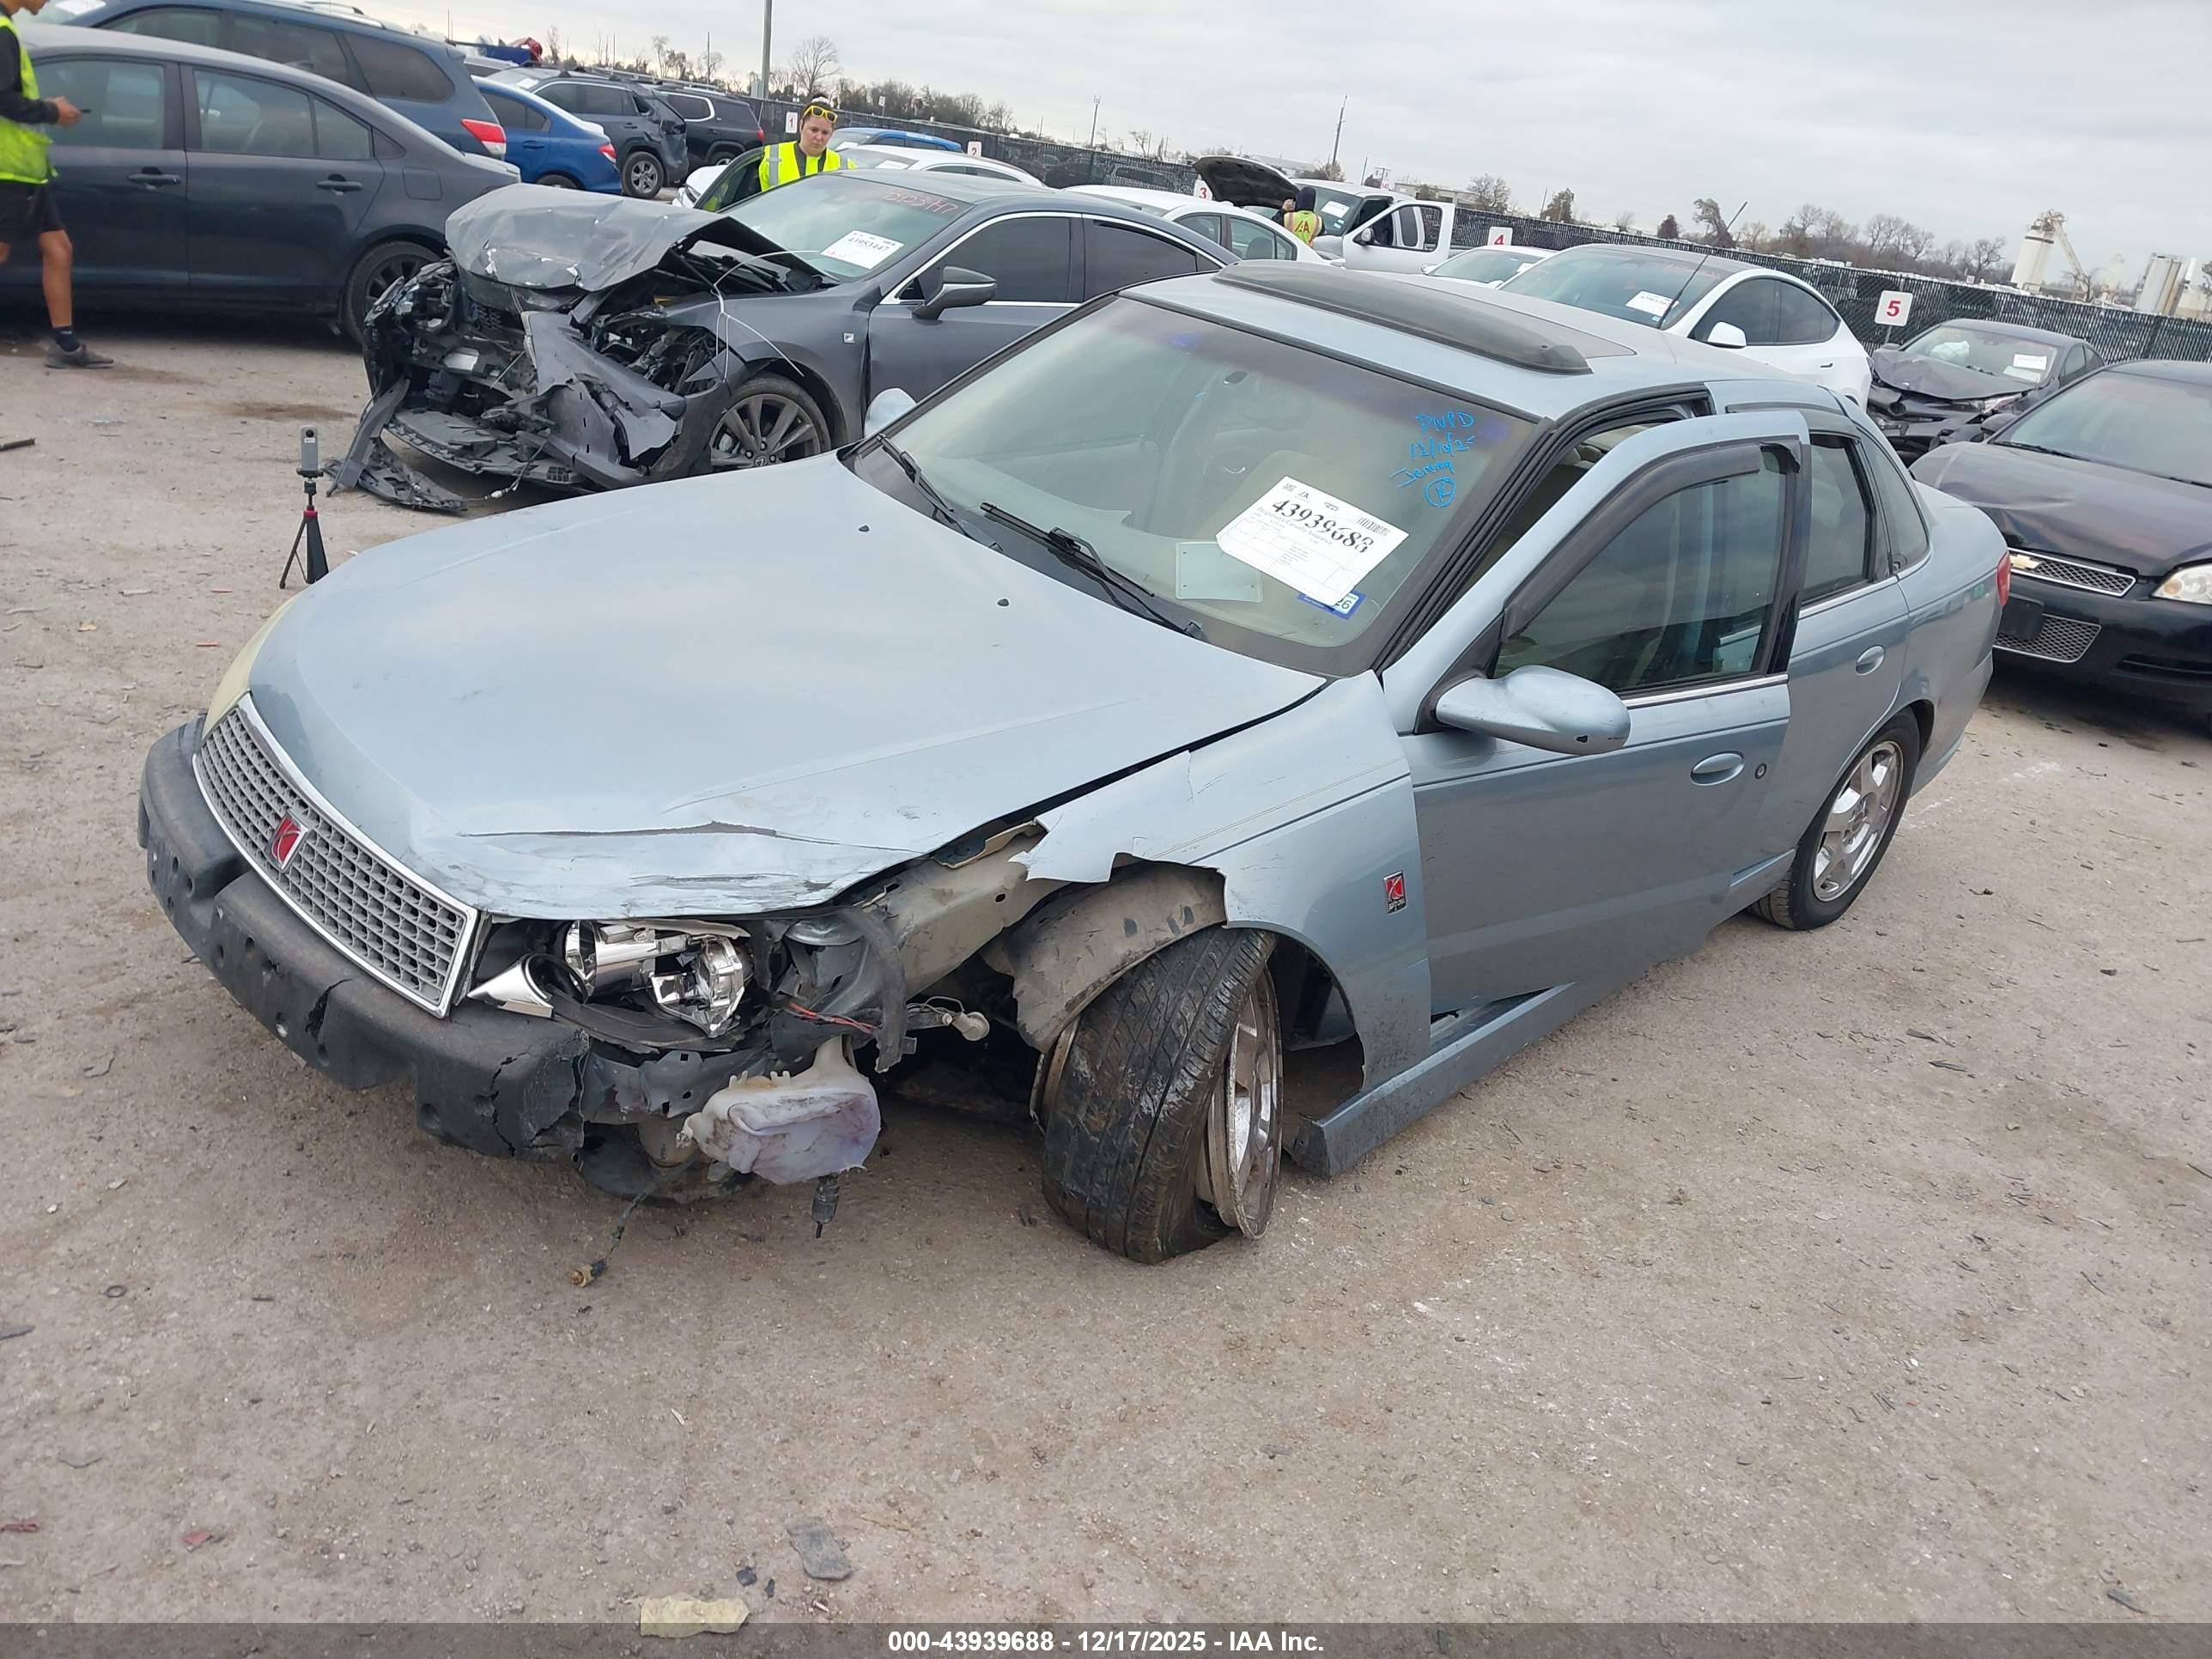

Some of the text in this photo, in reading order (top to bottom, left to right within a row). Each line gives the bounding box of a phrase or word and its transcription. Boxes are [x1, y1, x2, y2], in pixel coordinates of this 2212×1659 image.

[1199, 186, 1207, 199] 3
[1493, 234, 1504, 245] 4
[1886, 300, 1901, 317] 5
